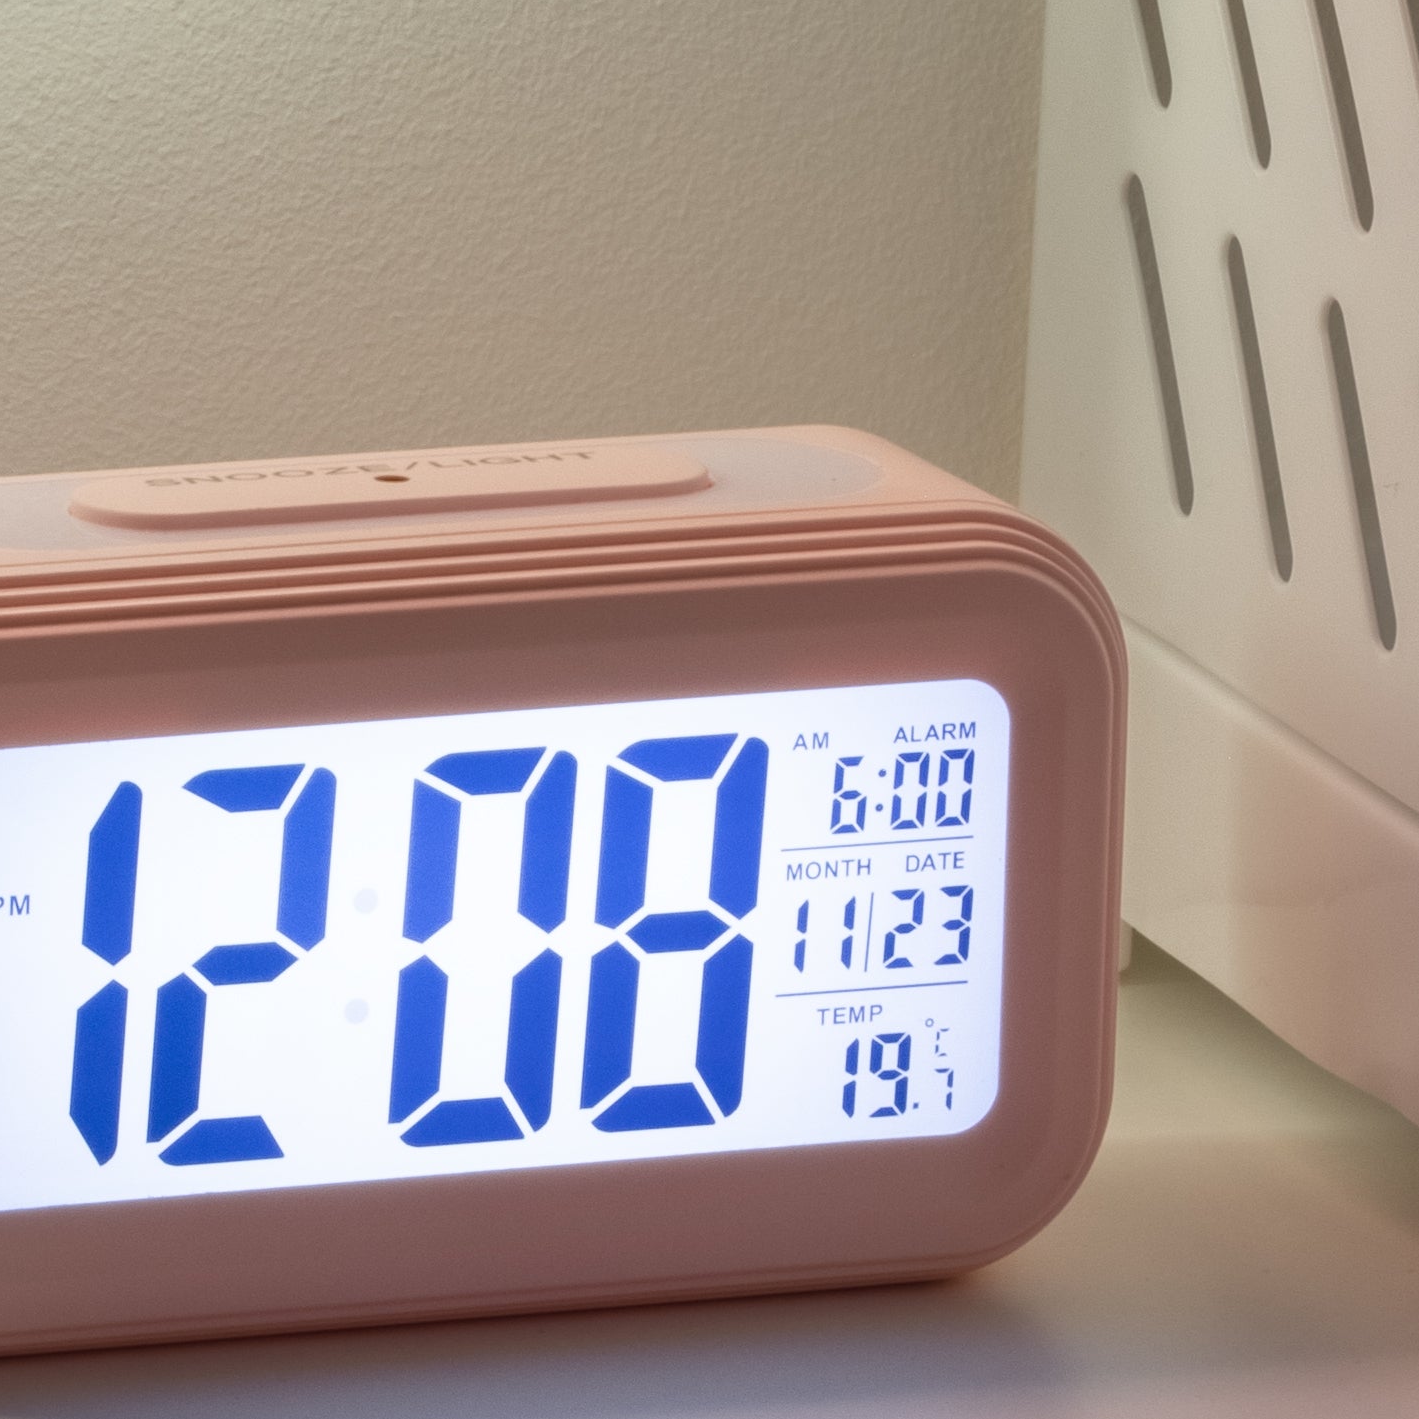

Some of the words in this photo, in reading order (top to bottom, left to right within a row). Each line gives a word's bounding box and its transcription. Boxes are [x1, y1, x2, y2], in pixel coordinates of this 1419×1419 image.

[146, 450, 596, 488] SNOOZE/LIGHT
[793, 732, 829, 750] AM
[893, 721, 976, 743] ALARM
[829, 748, 975, 835] 6:00
[787, 858, 871, 880] MONTH
[906, 851, 965, 872] DATE
[817, 1004, 883, 1025] TEMP
